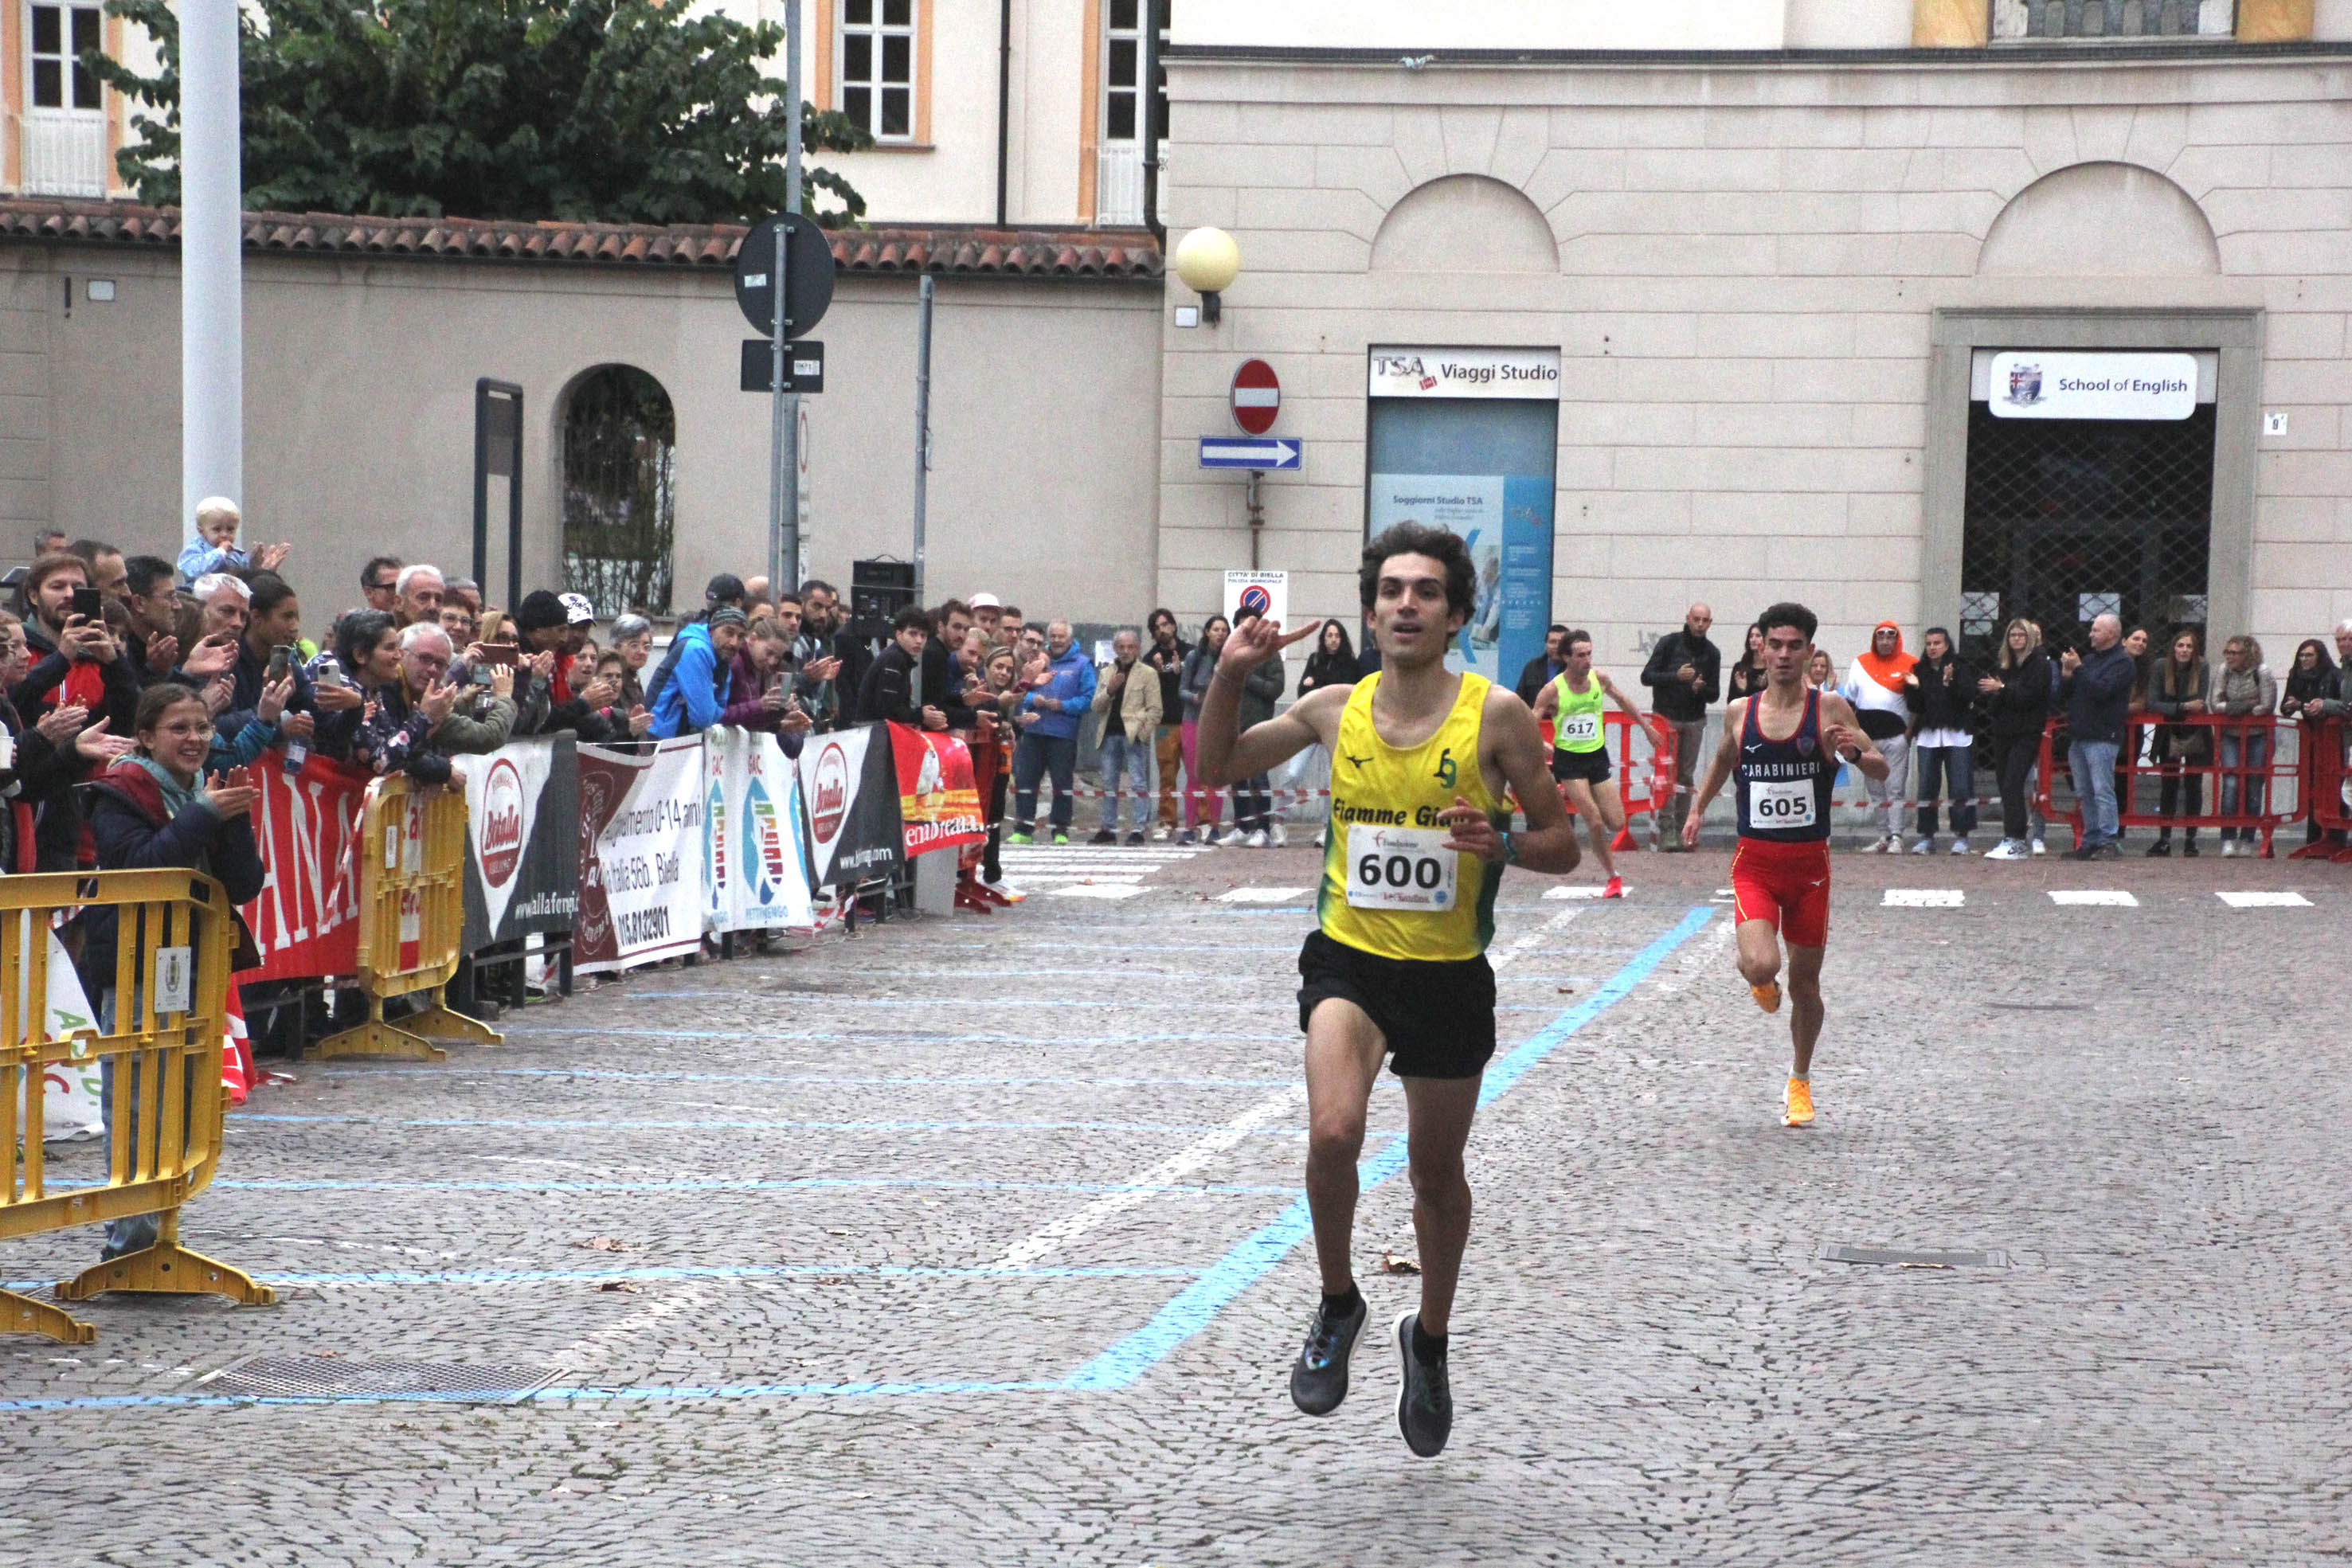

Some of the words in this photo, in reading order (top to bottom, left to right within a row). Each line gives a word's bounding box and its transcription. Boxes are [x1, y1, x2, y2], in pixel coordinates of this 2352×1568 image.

[1374, 356, 1425, 377] TSA
[1441, 363, 1496, 383] Viaggi
[1501, 364, 1558, 381] Studio
[2059, 378, 2110, 391] School
[2114, 378, 2129, 391] of
[2133, 379, 2188, 395] English
[1393, 495, 1434, 505] Soggiorni
[1567, 722, 1594, 734] 617
[1741, 761, 1820, 777] CARABINIERI
[1333, 798, 1407, 825] Fiamme
[1759, 796, 1807, 816] 605
[1359, 854, 1442, 890] 600
